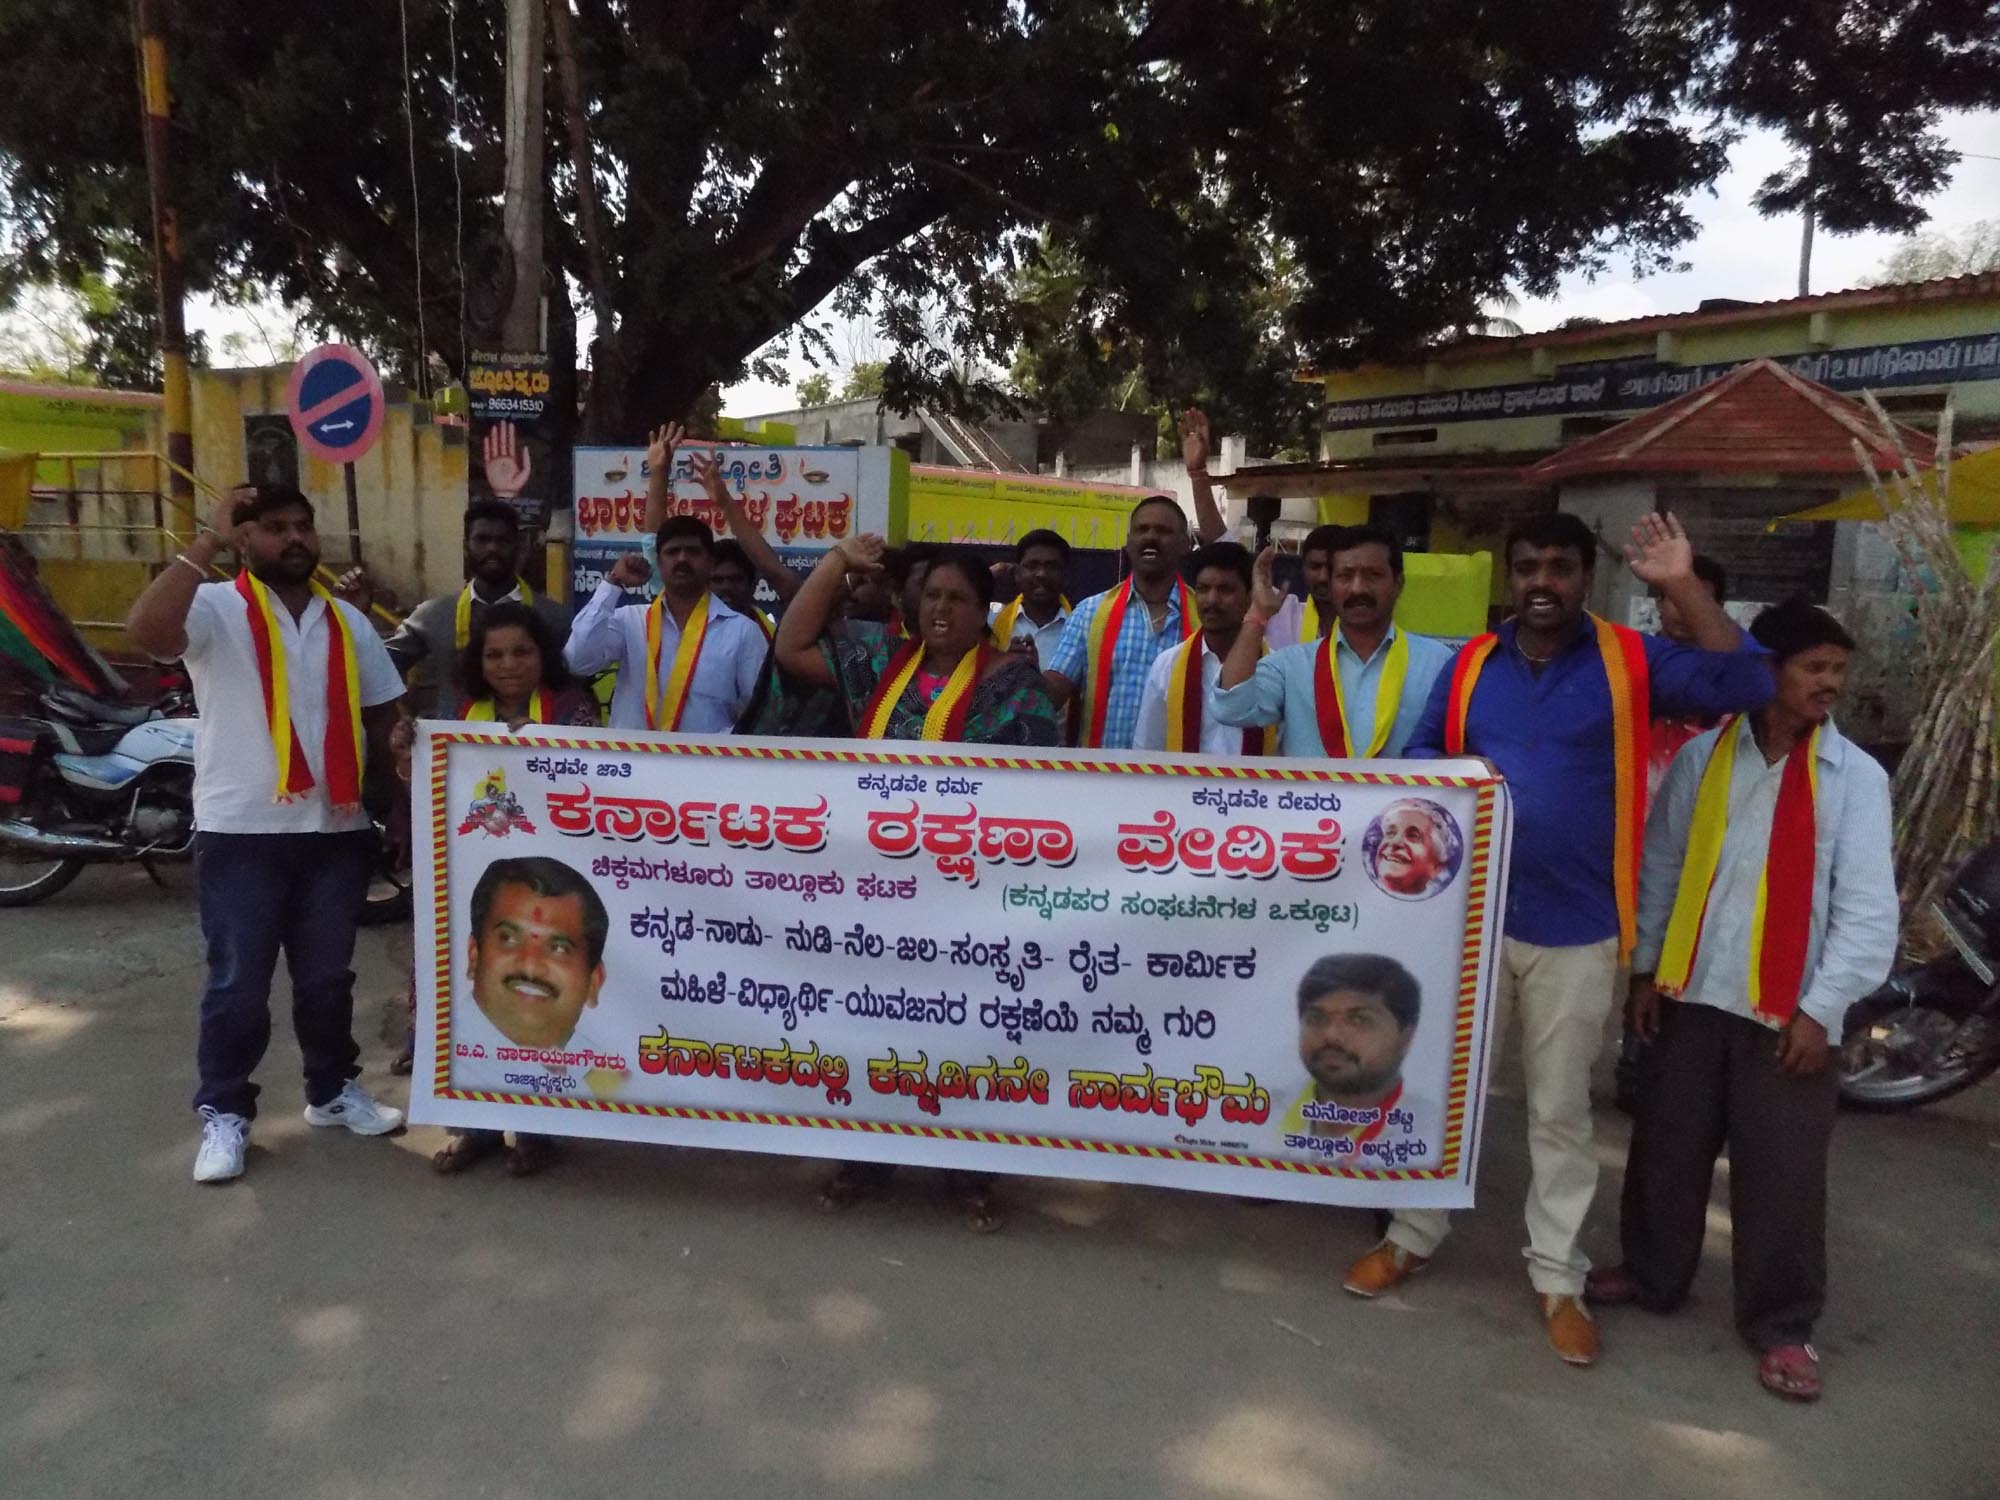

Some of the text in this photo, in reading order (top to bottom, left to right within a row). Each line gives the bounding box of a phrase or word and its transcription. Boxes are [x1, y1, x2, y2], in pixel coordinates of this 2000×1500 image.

[488, 398, 544, 411] 9663415310
[775, 492, 853, 544] ಘಟಕ
[526, 756, 632, 782] ಕನ್ನಡವೇ ಜಾತಿ
[857, 773, 983, 800] ಕನ್ನಡವೇ ಧರ್ಮ
[1192, 788, 1342, 815] ಕನ್ನಡವೇ ದೇವರು
[546, 782, 1346, 888] ಕರ್ನಾಟಕ ರಕ್ಷಣಾ ವೇದಿಕೆ
[592, 856, 918, 903] ಚಿಕ್ಕಮಗಳೂರು ತಾಲ್ಲೂಕು ಘಟಕ
[1001, 884, 1360, 933] (ಕನ್ನಡಪರ ಸಂಘಟನೆಗಳ ಒಕ್ಕೂಟ)
[1147, 947, 1256, 980] ಕಾರ್ಮಿಕ
[1092, 1003, 1152, 1055] ನಮ್ಮ
[1164, 1006, 1216, 1040] ಗುರಿ
[496, 1046, 627, 1071] ನಾರಾಯಣಗೌಡರು
[504, 1072, 577, 1093] ರಾಜ್ಯಾಧ್ಯಕ್ಷರು
[638, 1025, 1272, 1127] ಕರ್ನಾಟಕದಲ್ಲಿ ಕನ್ನಡಿಗನೇ ಸಾರ್ವಭೌಮ
[1302, 1101, 1415, 1134] ಮನೋಜ್ ಶೆಟ್ಟಿ
[1284, 1134, 1428, 1167] ತಾಲ್ಲೂಕು ಅಧ್ಯಕ್ಷರು
